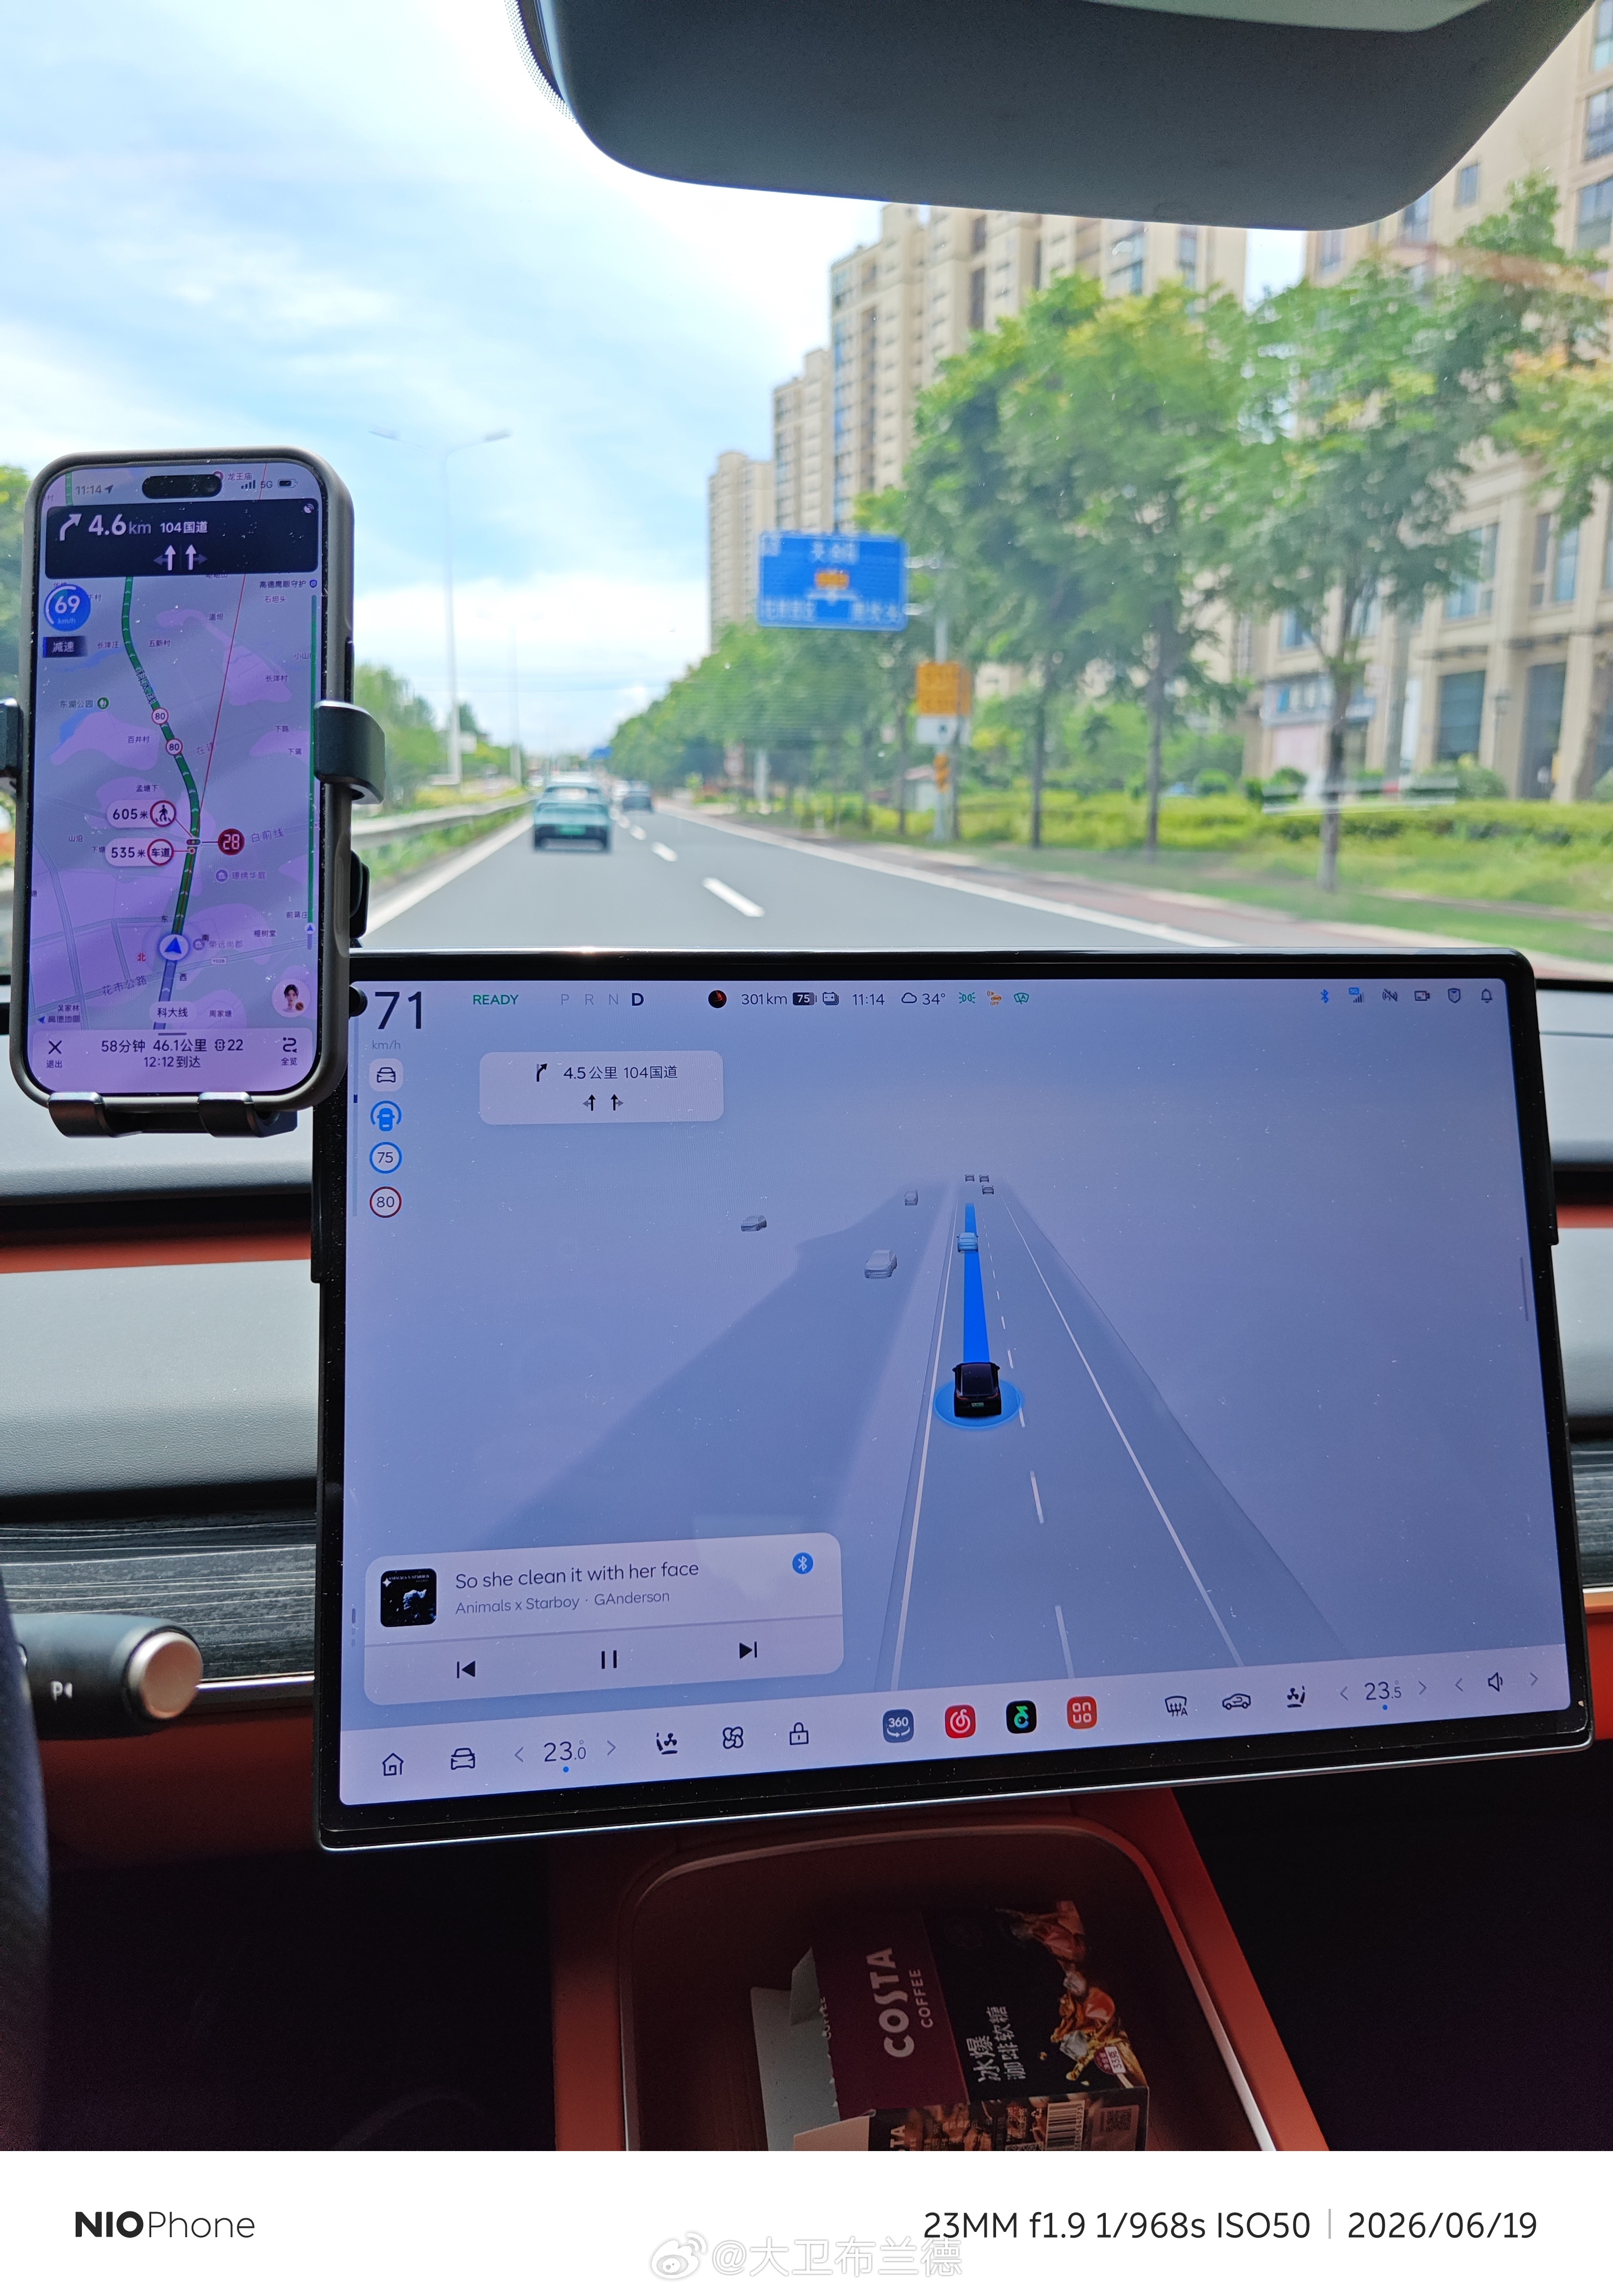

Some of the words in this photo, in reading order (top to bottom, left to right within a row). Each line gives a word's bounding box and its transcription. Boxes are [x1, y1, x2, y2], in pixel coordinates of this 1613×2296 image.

[227, 473, 253, 481] 龙王庙
[76, 485, 102, 495] 11:14
[160, 521, 208, 534] 104国道
[259, 580, 306, 589] 高德鹰眼守护
[55, 595, 80, 614] 69
[52, 641, 75, 653] 减速
[60, 699, 93, 708] 东湖公园
[169, 743, 180, 751] 80
[251, 828, 284, 843] 白前线
[223, 834, 240, 850] 28
[151, 848, 171, 858] 车道
[137, 952, 146, 962] 北
[102, 975, 147, 996] 花市公路
[473, 994, 519, 1005] READY
[561, 994, 569, 1005] P
[585, 994, 594, 1005] R
[609, 994, 619, 1005] N
[632, 993, 644, 1006] D
[797, 994, 810, 1003] 75
[852, 994, 885, 1005] 11:14
[922, 993, 945, 1005] 34°
[158, 1007, 188, 1018] 科大线
[374, 991, 422, 1030] 71
[101, 1040, 145, 1053] 58分钟
[153, 1039, 207, 1052] 46.1公里
[228, 1039, 244, 1051] 22
[372, 1040, 401, 1050] km/h
[46, 1060, 62, 1068] 退出
[144, 1056, 201, 1068] 12:12到达
[281, 1057, 298, 1066] 全览
[563, 1066, 617, 1080] 4.5公里
[623, 1065, 678, 1079] 104国道
[377, 1152, 394, 1164] 75
[376, 1196, 395, 1208] 80
[456, 1573, 478, 1590] So
[482, 1571, 514, 1588] she
[518, 1568, 567, 1587] clean
[570, 1567, 583, 1584] it
[586, 1564, 625, 1582] with
[629, 1562, 657, 1580] her
[661, 1560, 699, 1578] face
[456, 1599, 511, 1615] Animals
[526, 1595, 580, 1613] Starboy
[594, 1590, 670, 1606] GAnderson
[888, 1716, 909, 1728] 360
[866, 1947, 915, 2058] COSTA
[909, 1969, 934, 2028] COFFEE
[986, 2006, 1027, 2081] 咖啡软糖
[966, 2036, 1001, 2083] 冰爆
[1107, 2050, 1122, 2069] 33克
